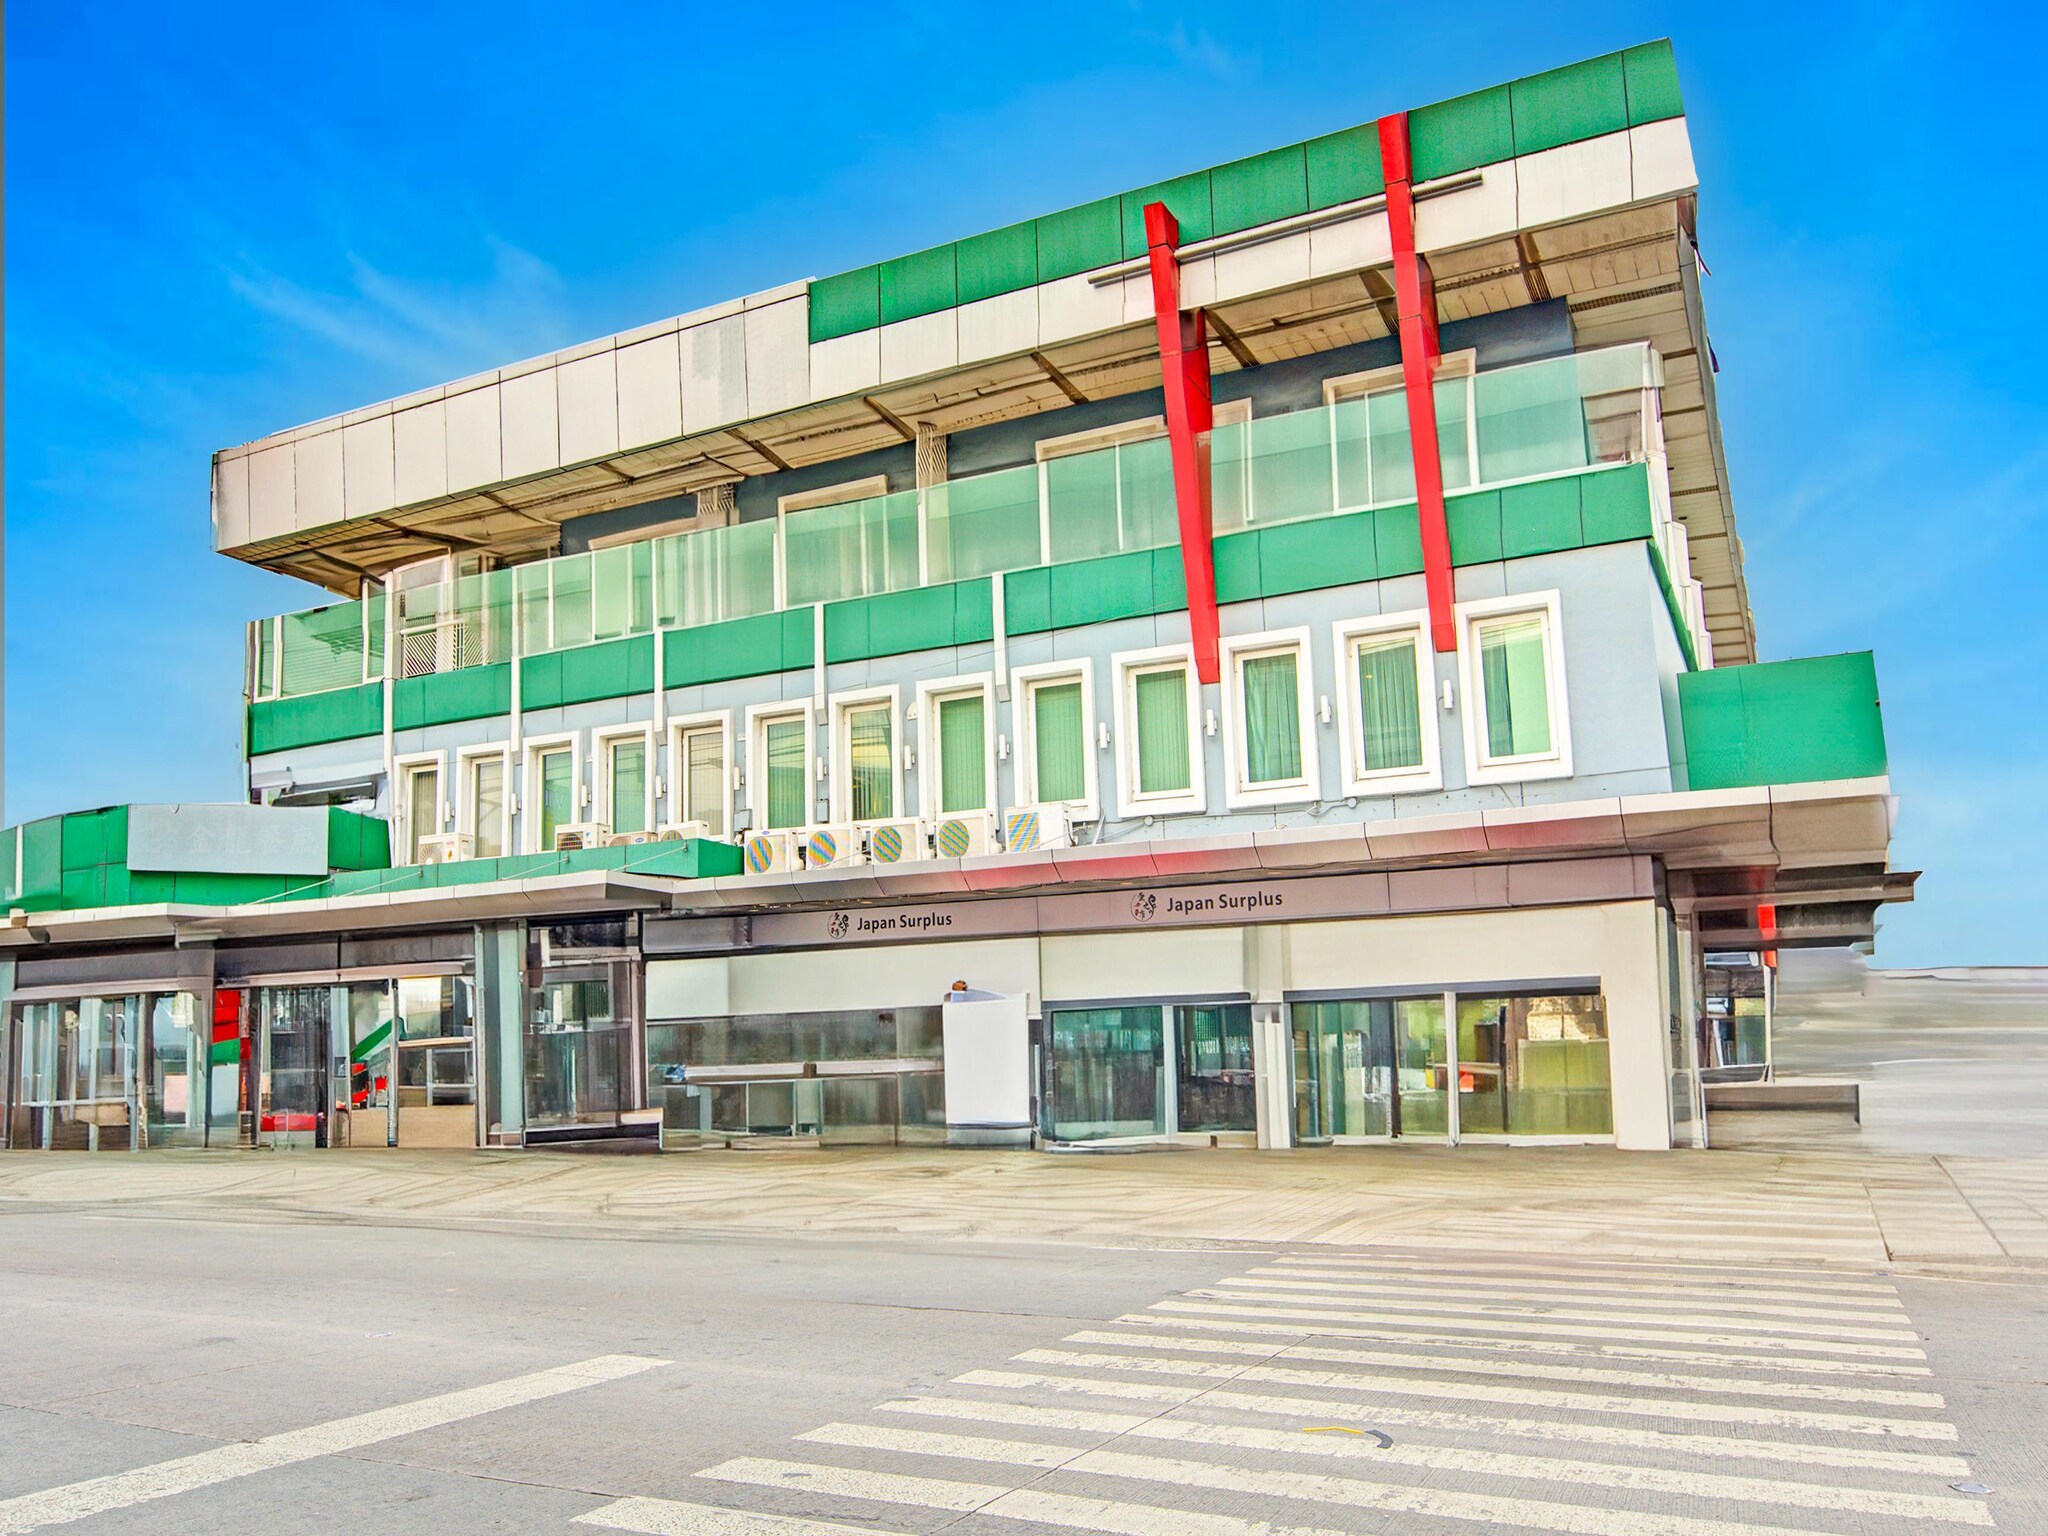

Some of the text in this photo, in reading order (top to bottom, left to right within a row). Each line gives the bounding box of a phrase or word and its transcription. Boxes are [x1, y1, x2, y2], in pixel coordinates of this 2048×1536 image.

[1166, 897, 1214, 915] Japan
[1218, 891, 1283, 911] Surplus
[857, 917, 896, 933] Japan
[899, 912, 952, 931] Surplus
